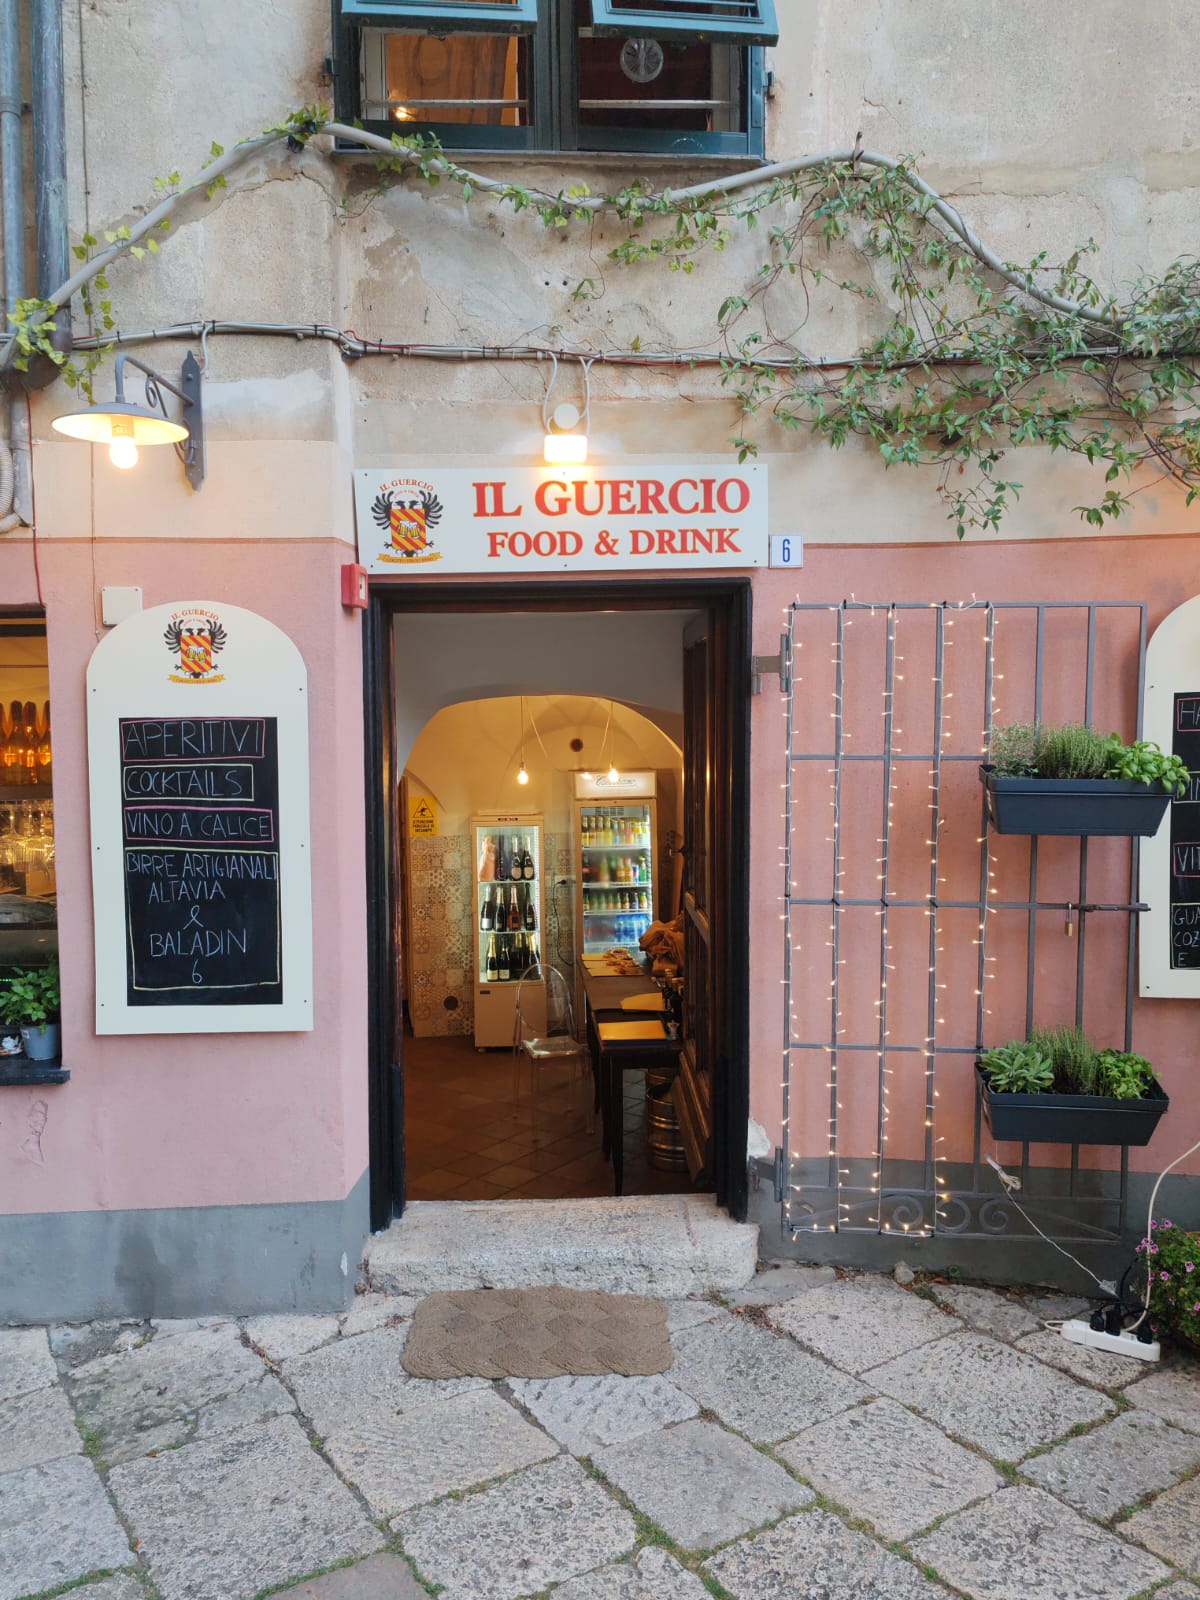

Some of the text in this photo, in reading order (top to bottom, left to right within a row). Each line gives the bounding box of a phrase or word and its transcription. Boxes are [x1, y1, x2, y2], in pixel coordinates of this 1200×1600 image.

[391, 479, 435, 492] GUERCIO
[472, 478, 751, 518] IL GUERCIO
[487, 528, 742, 557] FOOD & DRINK
[781, 538, 791, 563] 6
[181, 608, 219, 621] GUERCIO
[124, 720, 260, 757] APERITIVI
[127, 769, 243, 796] COCKTAILS
[127, 811, 270, 838] VINO A CALICE
[126, 852, 277, 880] BIRRE ARTIGIANALI
[148, 880, 226, 904] ALTAVIA
[150, 928, 247, 957] BALADIN
[191, 958, 203, 984] 6
[1177, 951, 1189, 967] E
